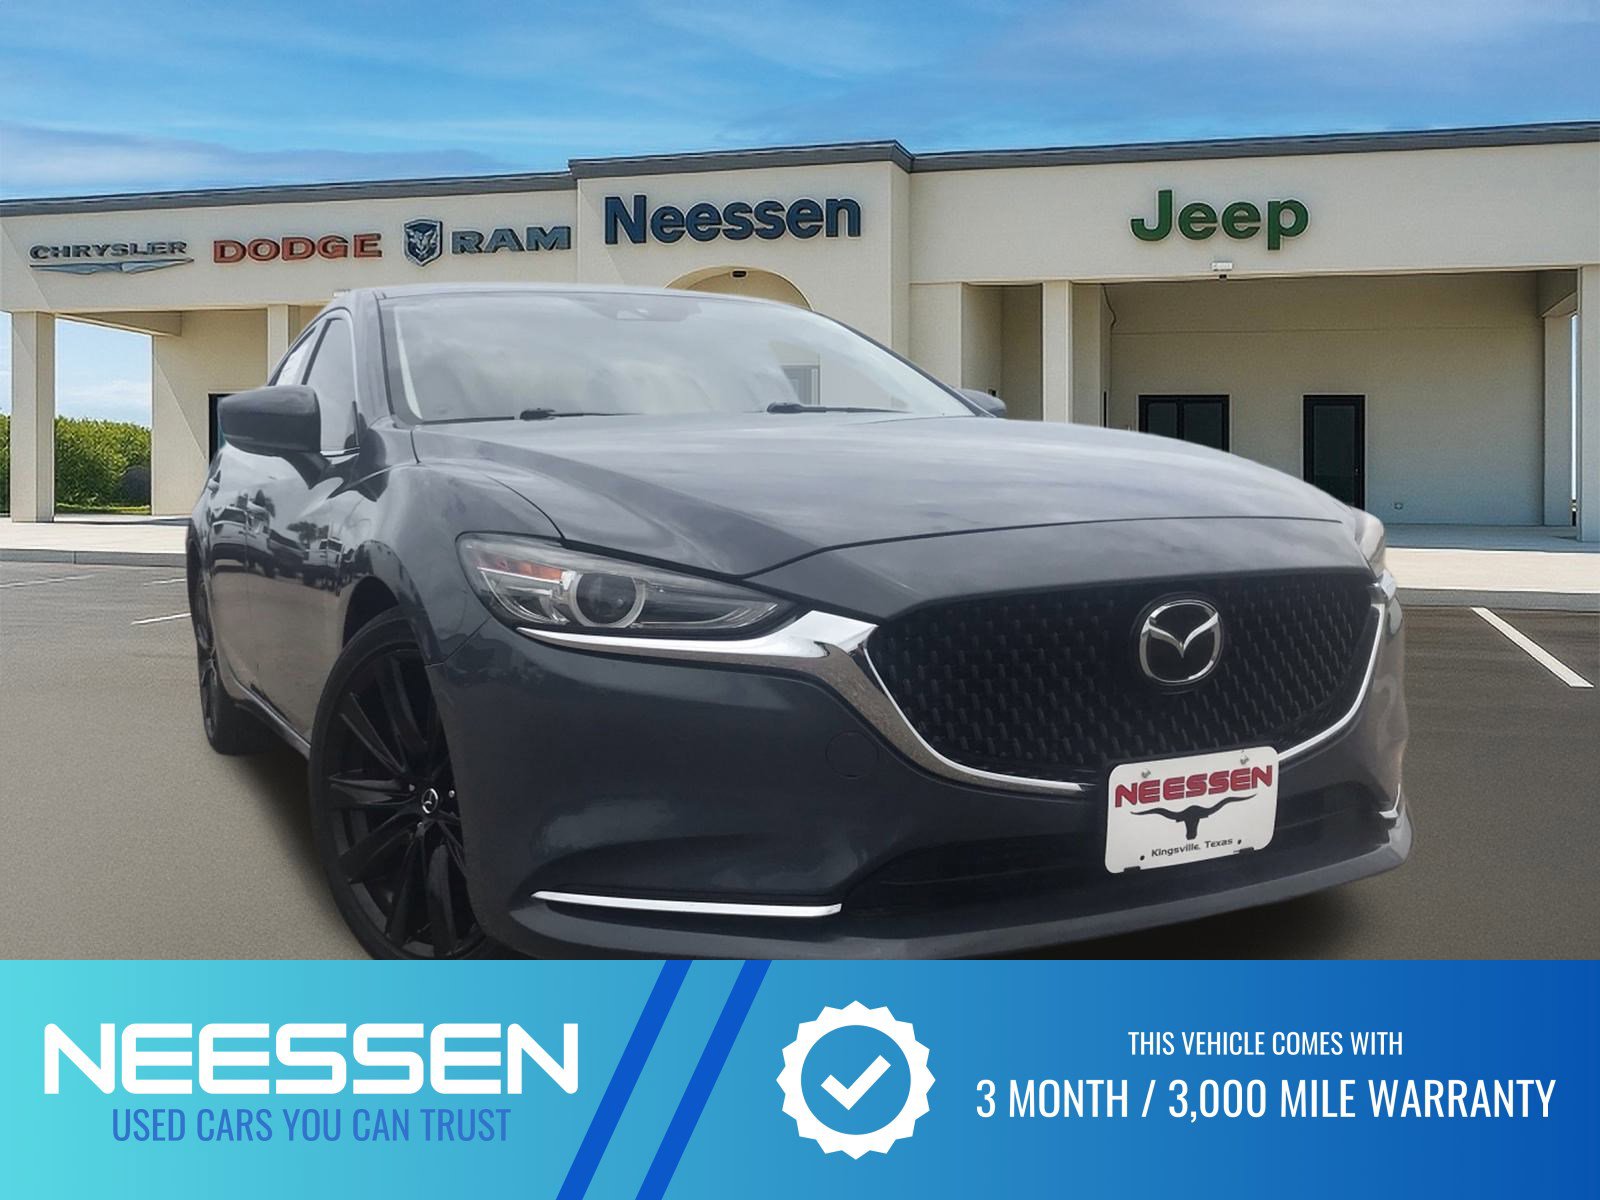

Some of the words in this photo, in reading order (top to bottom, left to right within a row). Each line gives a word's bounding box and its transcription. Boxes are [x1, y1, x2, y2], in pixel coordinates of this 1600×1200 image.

[604, 194, 862, 245] Neessen
[1130, 189, 1310, 251] Jeep
[29, 240, 188, 261] CHRYSLER
[213, 233, 382, 264] DODGE
[451, 225, 572, 254] RAM
[1114, 765, 1273, 808] NEESSEN
[1204, 839, 1233, 848] Texas
